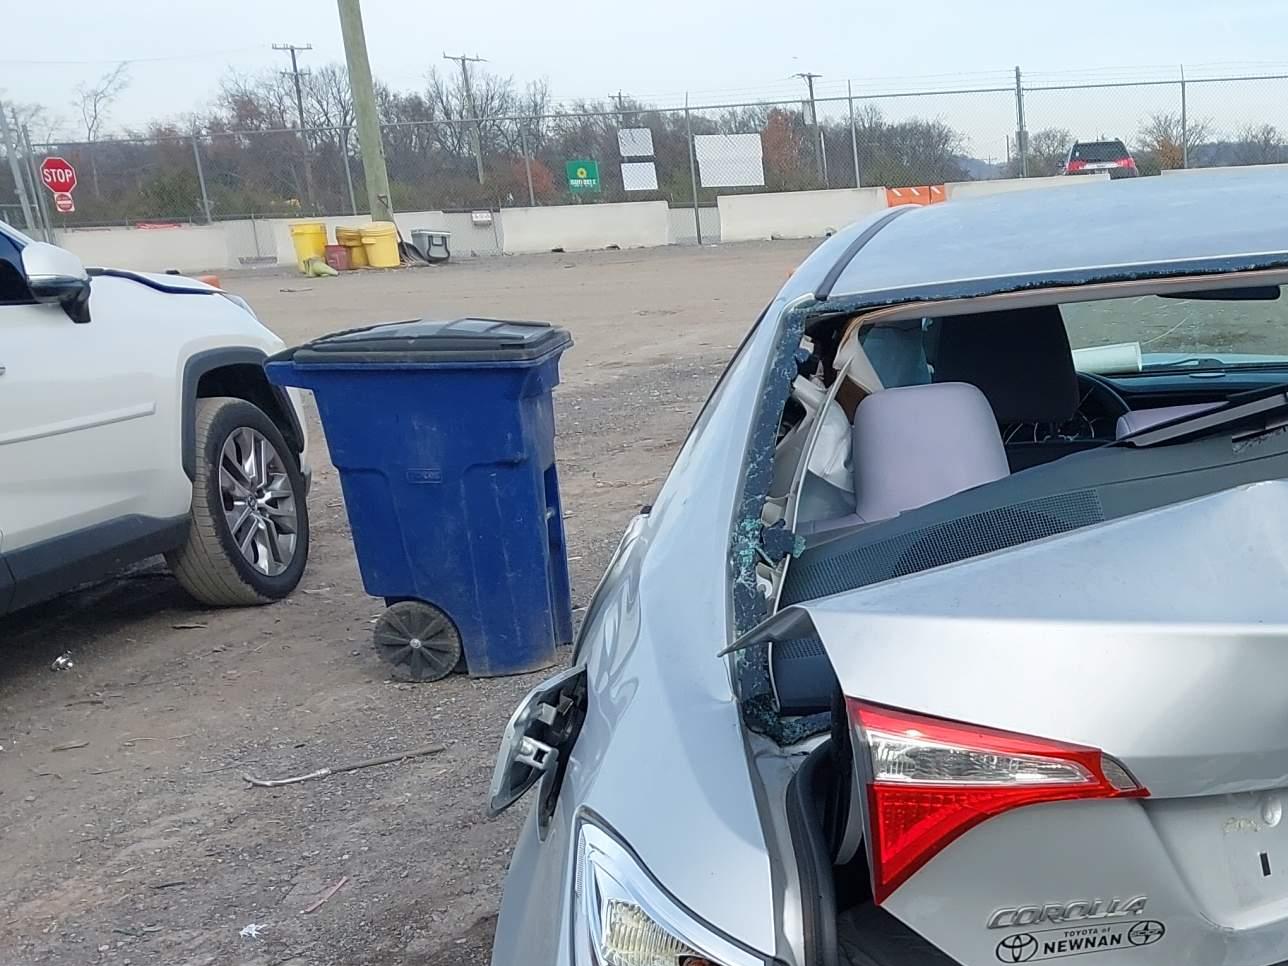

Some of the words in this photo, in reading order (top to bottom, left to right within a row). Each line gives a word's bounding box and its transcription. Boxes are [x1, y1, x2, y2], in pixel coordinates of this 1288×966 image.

[43, 168, 73, 183] STOP
[987, 896, 1148, 930] COROLLA
[1063, 928, 1099, 938] TOYOTA
[1043, 933, 1122, 954] NEWNAN
